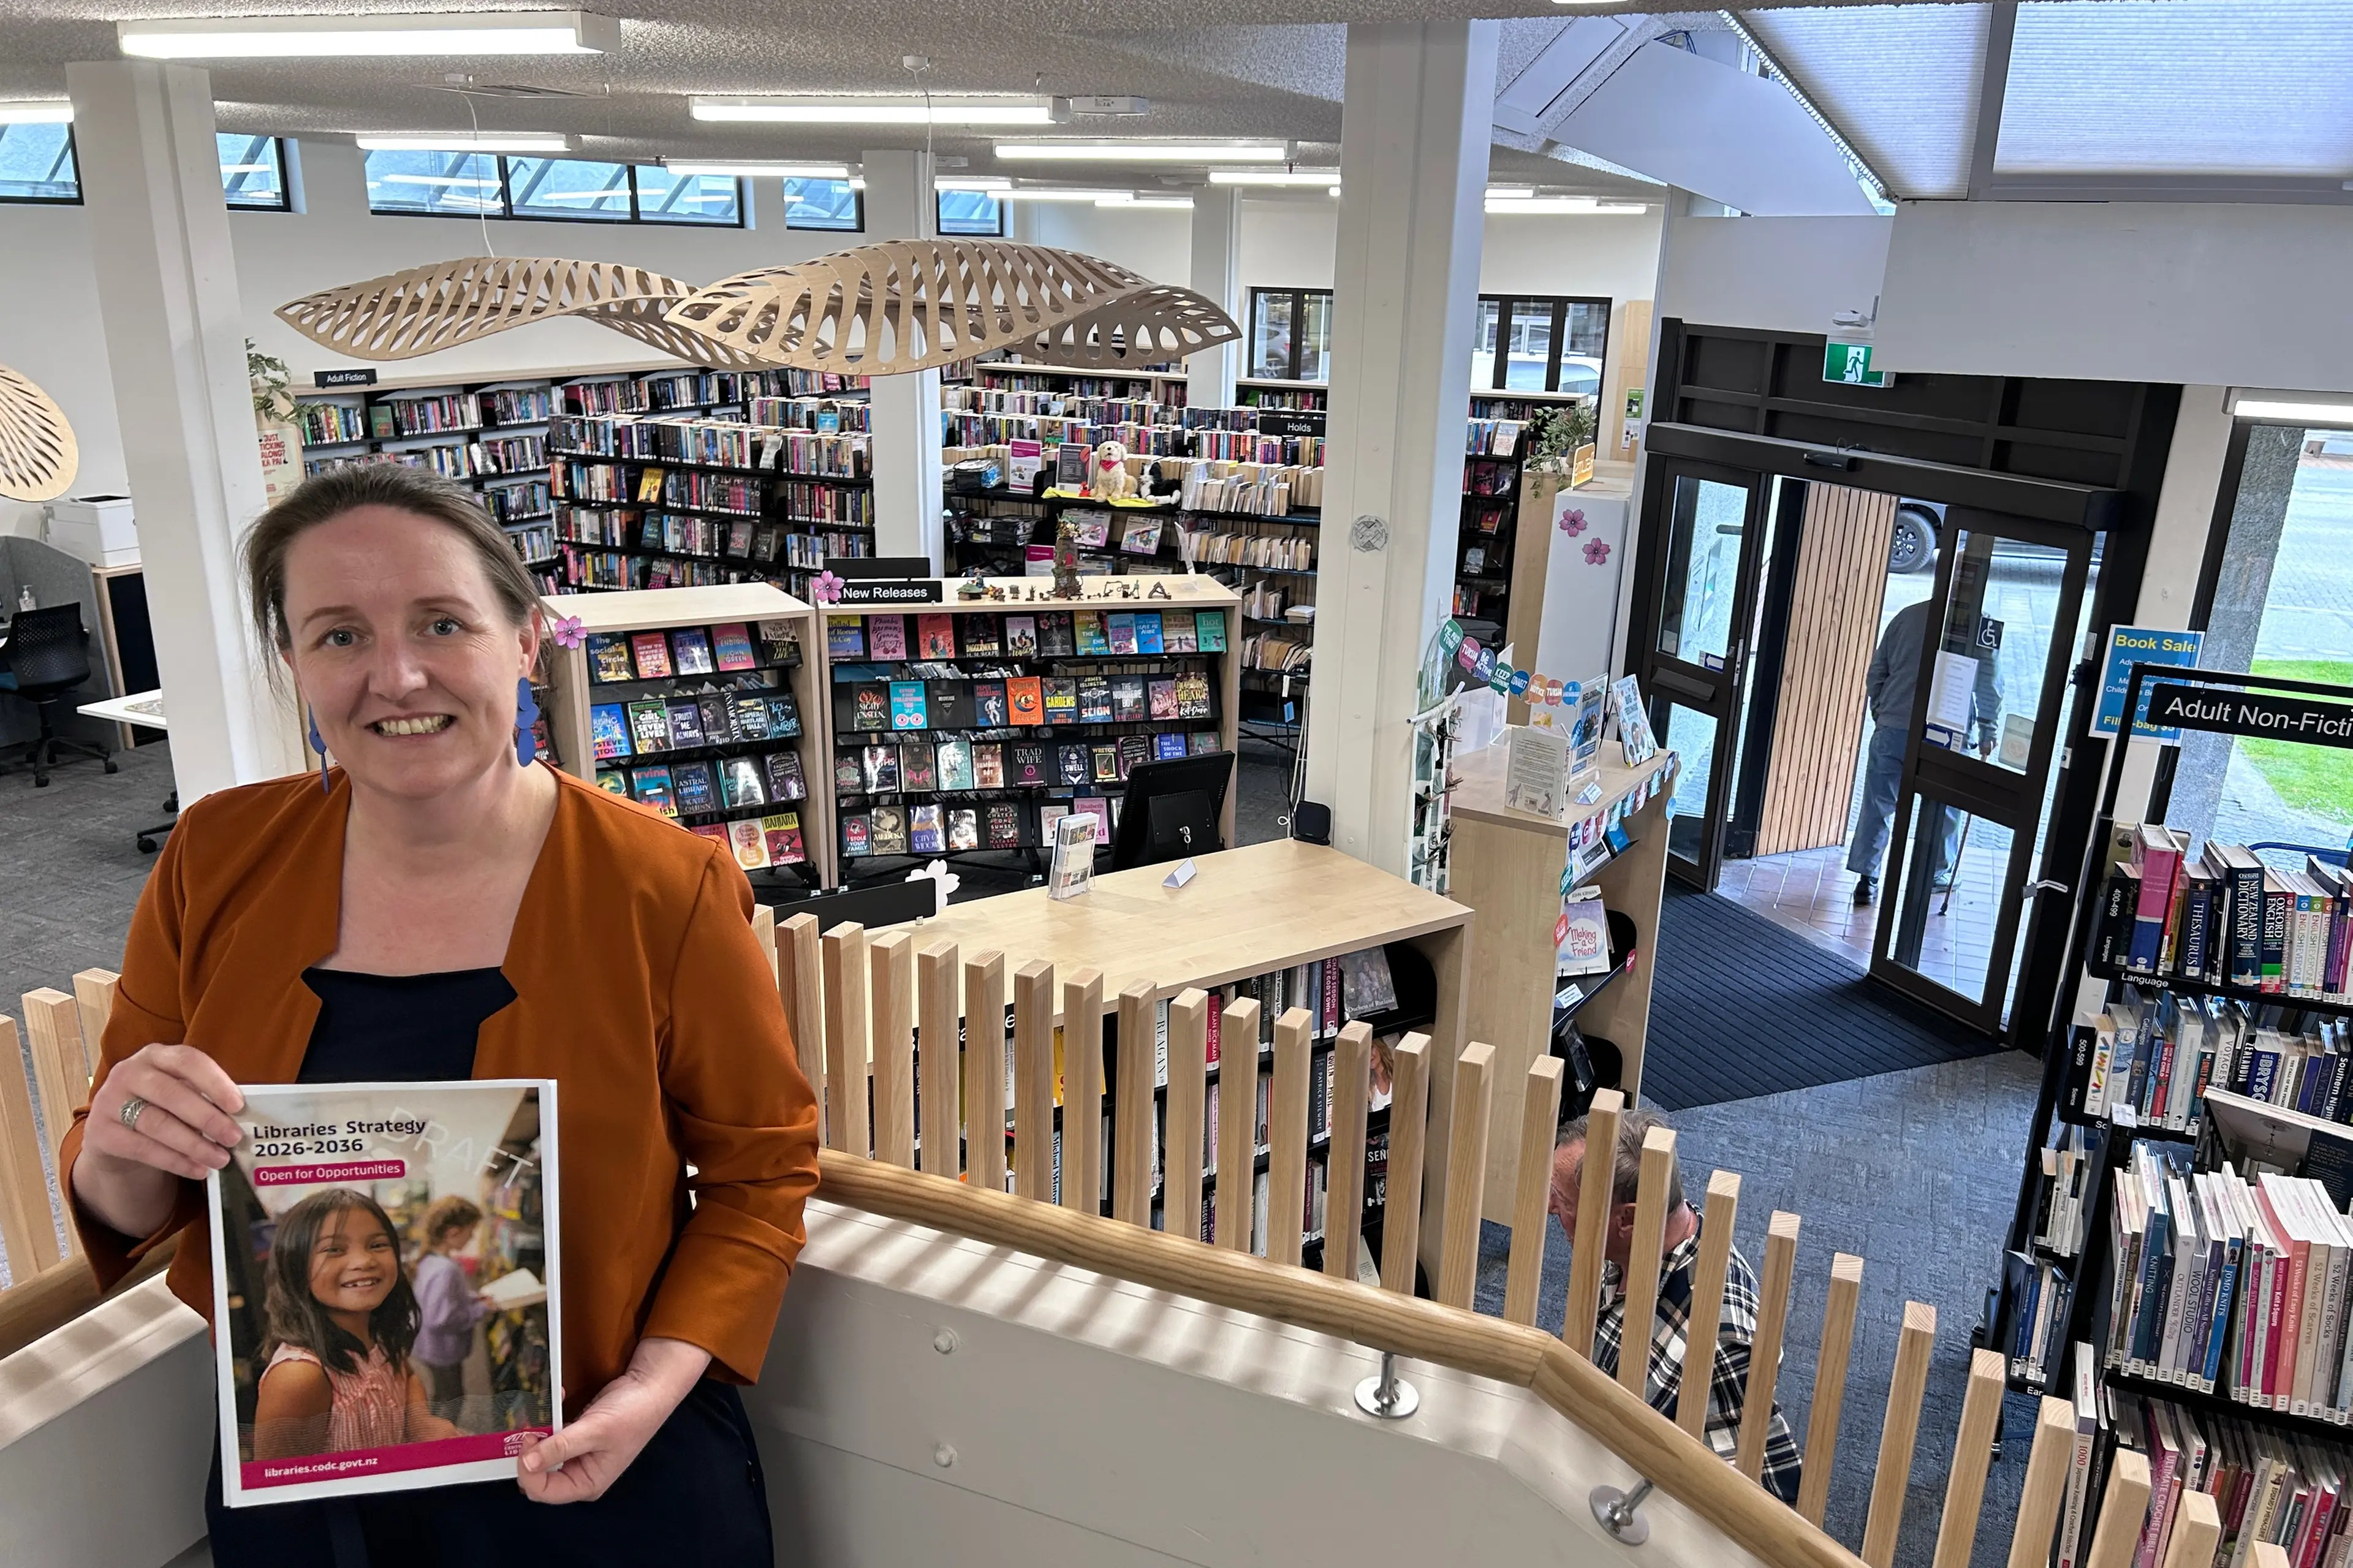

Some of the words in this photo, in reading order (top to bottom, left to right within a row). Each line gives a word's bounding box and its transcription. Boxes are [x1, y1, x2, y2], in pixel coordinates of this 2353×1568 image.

[327, 374, 344, 382] Adult
[345, 373, 366, 382] Fiction
[1287, 422, 1312, 432] Holds
[260, 441, 285, 450] TICKING
[261, 449, 286, 458] ALONG?
[843, 588, 870, 599] New
[873, 586, 928, 598] Releases
[590, 646, 615, 654] social
[2115, 634, 2157, 650] Book
[2162, 638, 2197, 653] Sale
[1475, 661, 1492, 677] ACTIVE
[1495, 667, 1510, 680] KEEP
[1491, 676, 1509, 689] LEARNING
[1511, 675, 1528, 689] CONNECT
[1529, 684, 1545, 697] NOTICE
[1046, 696, 1075, 708] GARDENS
[1113, 689, 1142, 699] NOWHERE
[1122, 699, 1134, 707] BOY
[638, 713, 660, 721] GIRL
[674, 712, 693, 721] TRUST
[857, 711, 886, 719] UNSEEN
[1082, 706, 1110, 718] SCION
[2165, 697, 2232, 722] Adult
[605, 724, 621, 732] THE
[637, 723, 665, 732] SEVEN
[676, 729, 699, 741] ALWAYS
[680, 721, 690, 729] ME
[1015, 748, 1042, 757] TRAD
[678, 786, 708, 795] LIBRARY
[773, 856, 803, 866] CHANDRA
[2249, 881, 2259, 900] NEW
[2109, 888, 2121, 917] 400-499
[2237, 881, 2249, 940] DICTIONARY
[2248, 901, 2258, 940] ZEALAND
[2264, 898, 2276, 938] ENGLISH
[2275, 897, 2286, 938] OXFORD
[1571, 927, 1596, 944] Making
[2187, 903, 2204, 965] THESAURUS
[2297, 914, 2307, 944] ENGLISH
[2309, 915, 2319, 949] ENGLISH
[2322, 916, 2331, 947] ENGLISH
[1571, 942, 1597, 957] Friend
[2102, 936, 2112, 962] Languages
[2294, 947, 2304, 983] EVERYONE
[2306, 950, 2316, 983] EVERYONE
[2121, 972, 2169, 988] Language
[1348, 1004, 1368, 1013] Duchess
[1375, 996, 1395, 1007] Rutland
[1157, 1020, 1165, 1074] REAGAN
[2076, 1039, 2087, 1066] 500-599
[2200, 1059, 2210, 1077] LONELY
[2218, 1040, 2234, 1081] VOYAGES
[2237, 1042, 2255, 1082] ZEALANDIA
[2251, 1059, 2273, 1102] BRYSO
[2335, 1057, 2348, 1096] Southern
[2070, 1088, 2078, 1105] Science
[2196, 1077, 2207, 1098] ISLANDS
[254, 1123, 336, 1140] Libraries
[346, 1119, 426, 1134] Strategy
[255, 1138, 363, 1157] 2026-2036
[380, 1106, 534, 1189] DRAFT
[259, 1170, 292, 1182] Open
[295, 1168, 313, 1179] for
[316, 1164, 400, 1180] Opportunities
[2145, 1255, 2159, 1293] KNITTING
[2297, 1260, 2303, 1269] 52
[2315, 1262, 2324, 1273] 52
[2333, 1264, 2341, 1274] 52
[2189, 1270, 2202, 1298] WOOL
[2207, 1269, 2217, 1292] Knitted
[2223, 1269, 2234, 1292] JOMO
[2294, 1269, 2303, 1290] Weeks
[2311, 1274, 2322, 1301] Weeks
[2329, 1275, 2340, 1302] Weeks
[2170, 1273, 2184, 1319] OUTLANDER
[2218, 1293, 2227, 1317] KNITS
[2309, 1302, 2316, 1311] of
[2183, 1299, 2198, 1333] STUDIO
[2327, 1304, 2335, 1312] of
[2198, 1323, 2207, 1345] Seasons
[2305, 1312, 2316, 1346] Scarves
[2324, 1314, 2334, 1339] Socks
[2077, 1445, 2088, 1466] 1000
[265, 1456, 377, 1479] libraries.codc.govt.nz
[2159, 1455, 2175, 1492] ULTIMATE
[2074, 1467, 2083, 1490] Japanese
[2266, 1487, 2279, 1512] EDWARD'S
[2151, 1493, 2167, 1532] CROCHET
[2294, 1504, 2303, 1523] Tunisian
[2067, 1515, 2077, 1534] Crochet
[2258, 1513, 2270, 1542] MENAGERIE
[2288, 1524, 2297, 1545] Crochet
[2064, 1535, 2074, 1555] Stitches
[2146, 1532, 2158, 1555] BIBLE
